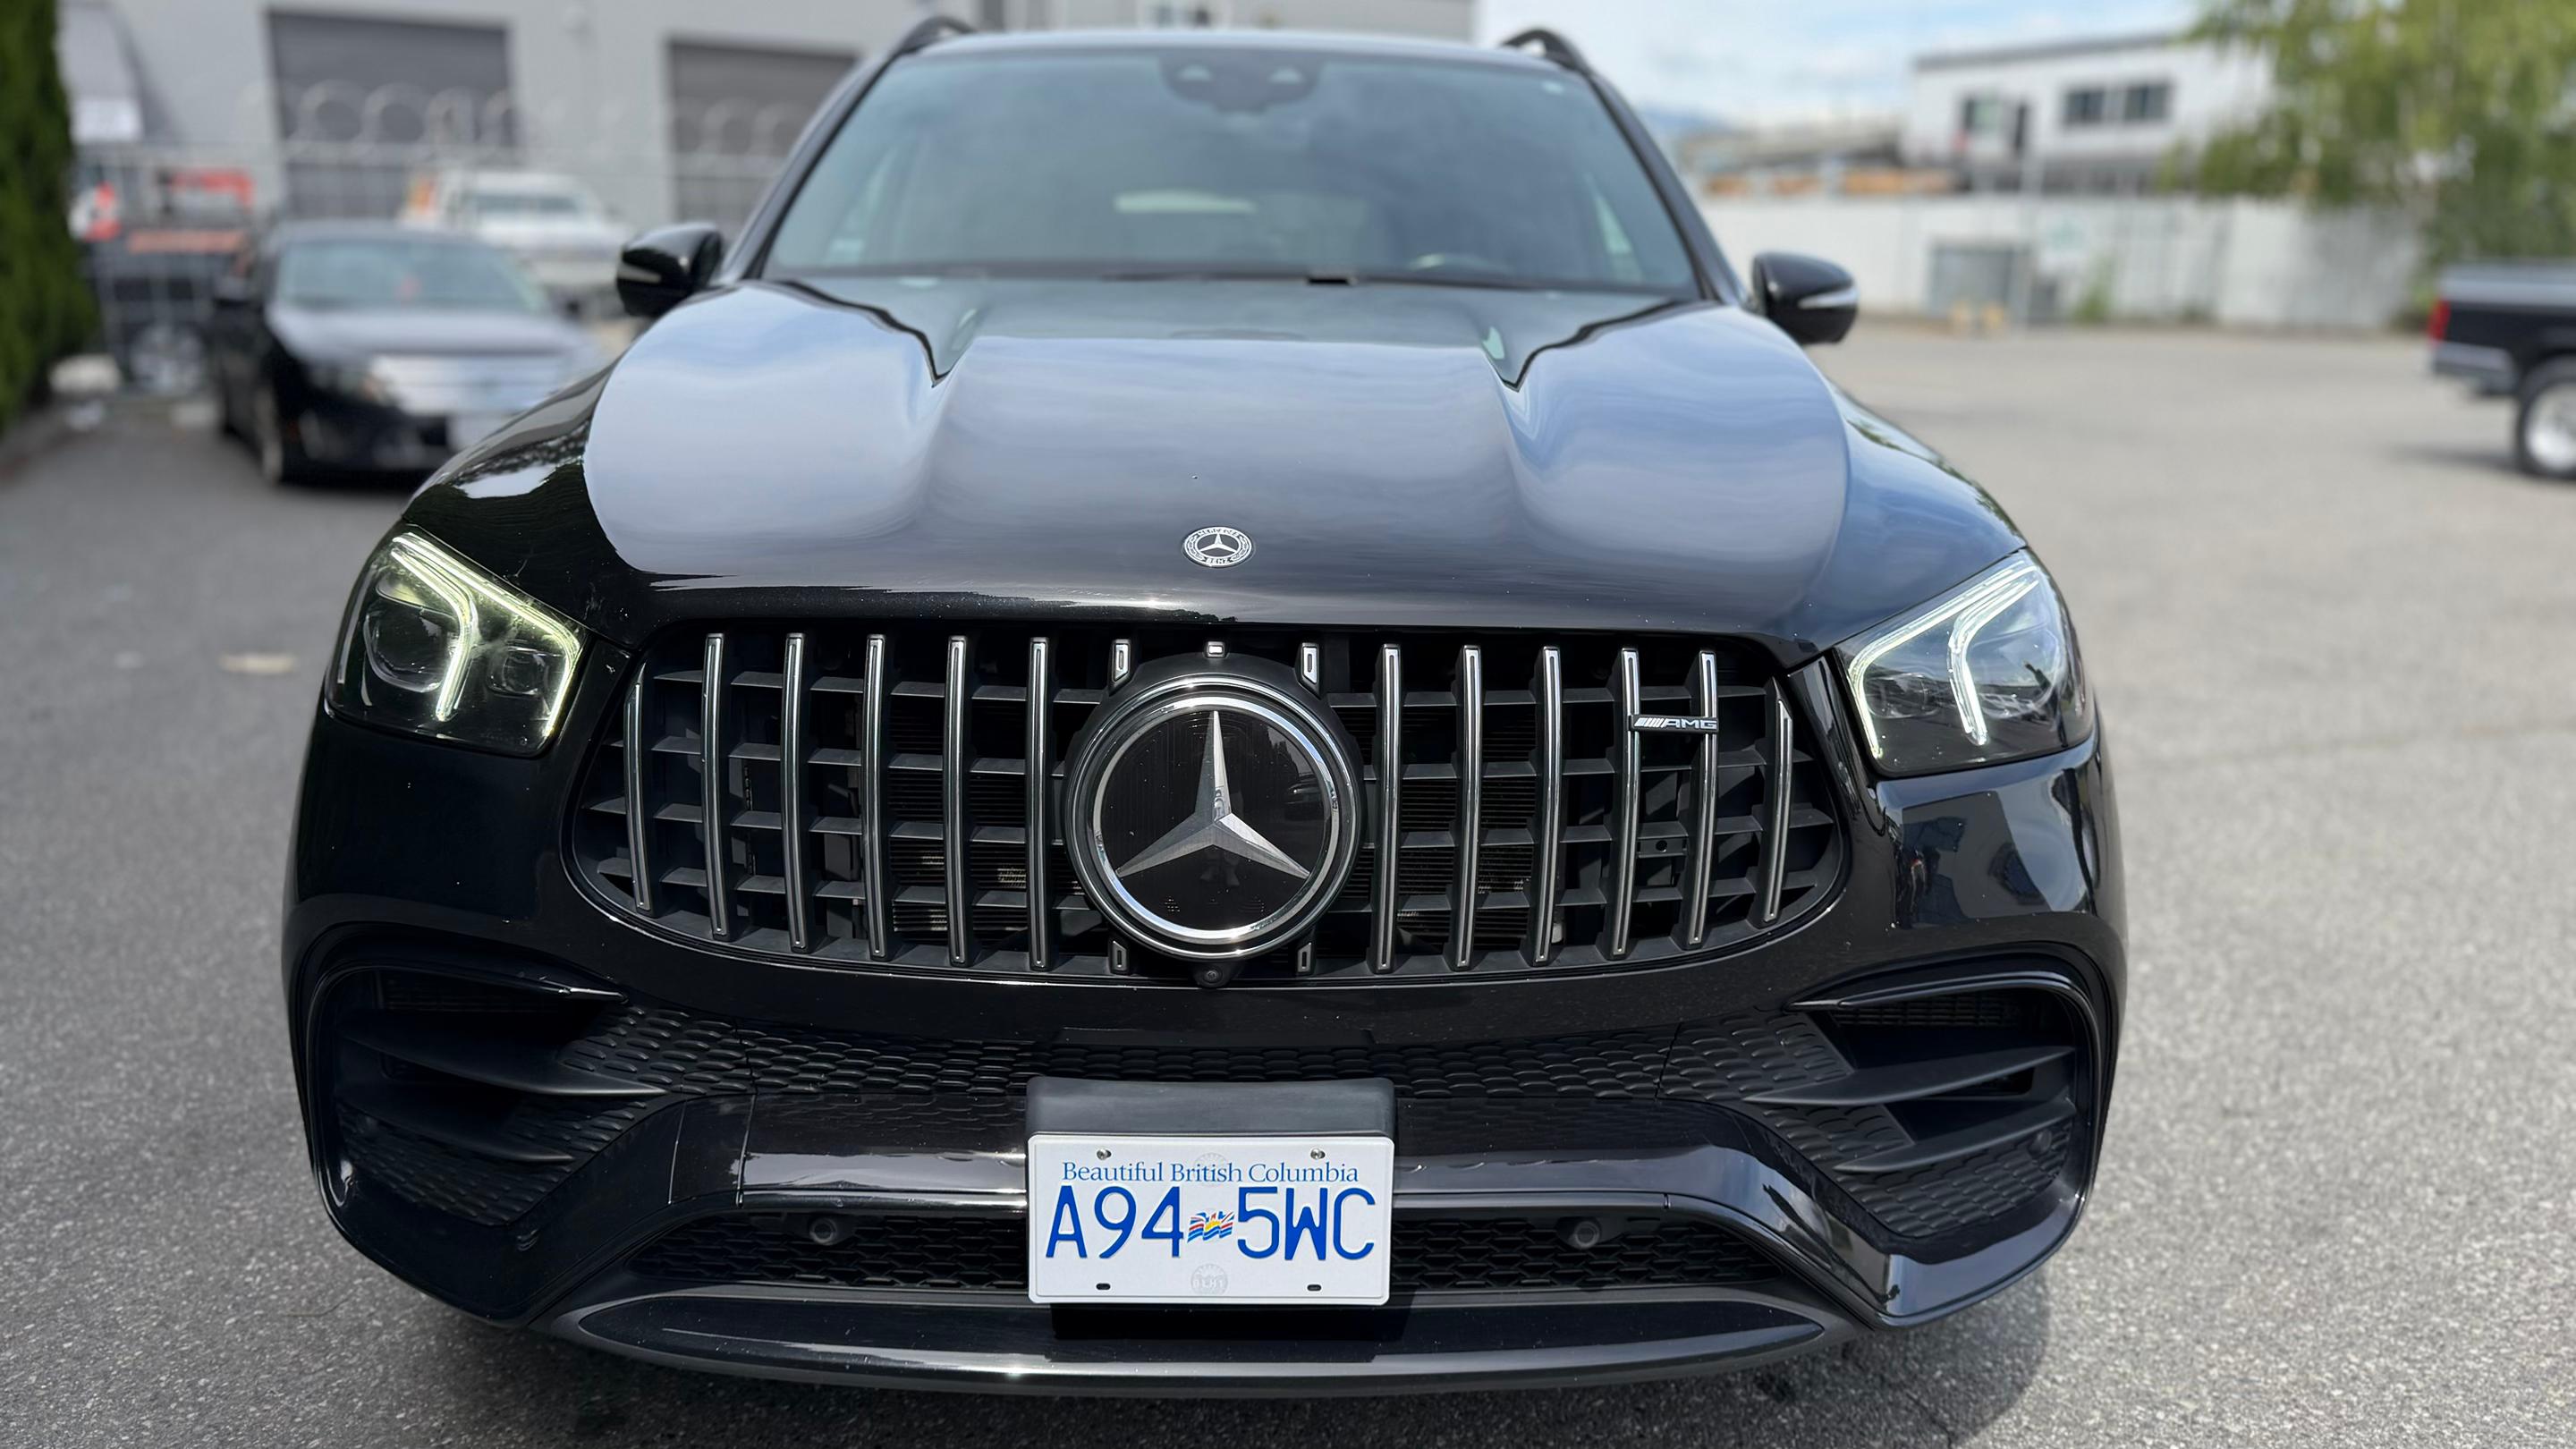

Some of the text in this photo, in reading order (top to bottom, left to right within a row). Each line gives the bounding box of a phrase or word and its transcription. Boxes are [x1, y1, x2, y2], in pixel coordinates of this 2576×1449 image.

[1663, 718, 1717, 729] AMG
[1063, 1162, 1359, 1182] Beautiful British Columbia
[1046, 1185, 1376, 1261] A94 5WC
